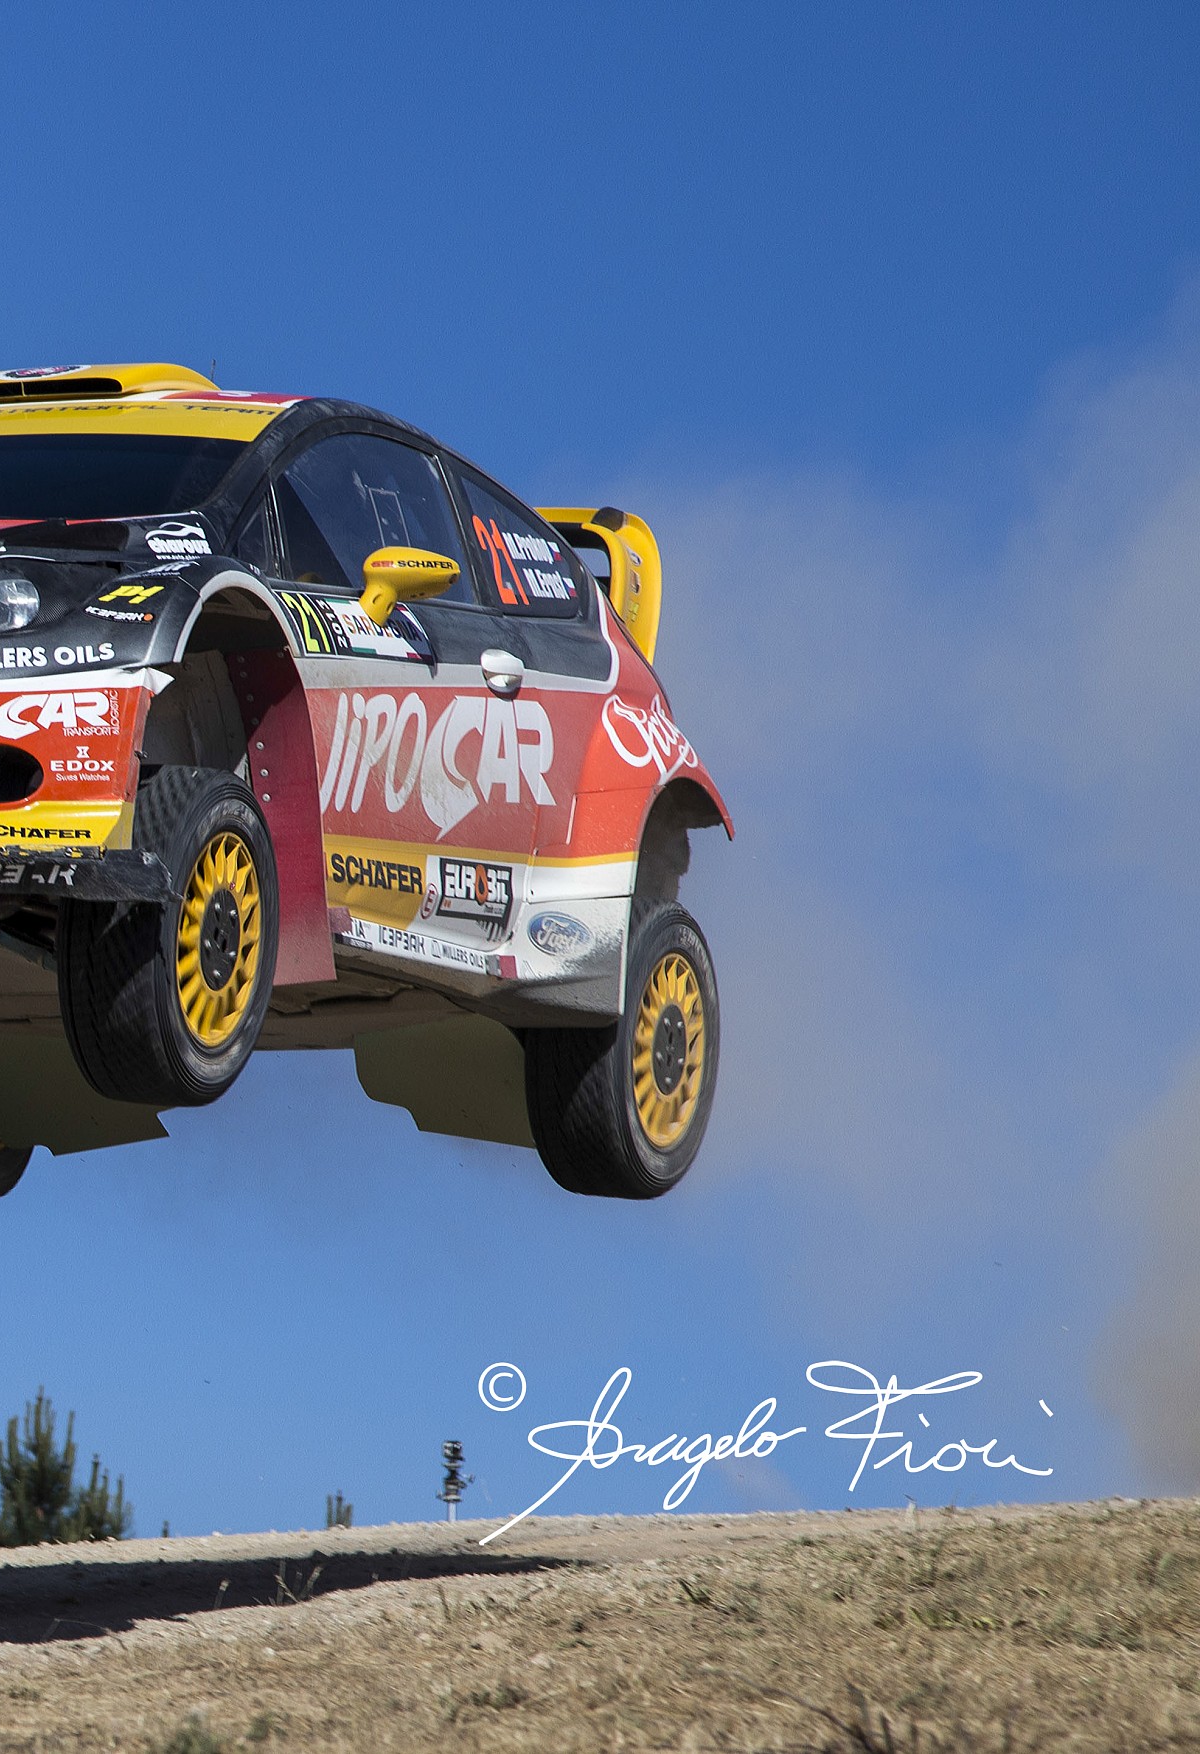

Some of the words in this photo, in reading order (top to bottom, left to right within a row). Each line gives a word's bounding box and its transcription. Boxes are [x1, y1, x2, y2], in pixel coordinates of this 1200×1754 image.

[472, 515, 530, 605] 21
[281, 592, 331, 653] 21
[315, 599, 349, 648] 2013
[54, 642, 115, 666] OILS
[50, 760, 115, 772] EDOX
[538, 919, 584, 949] Ford
